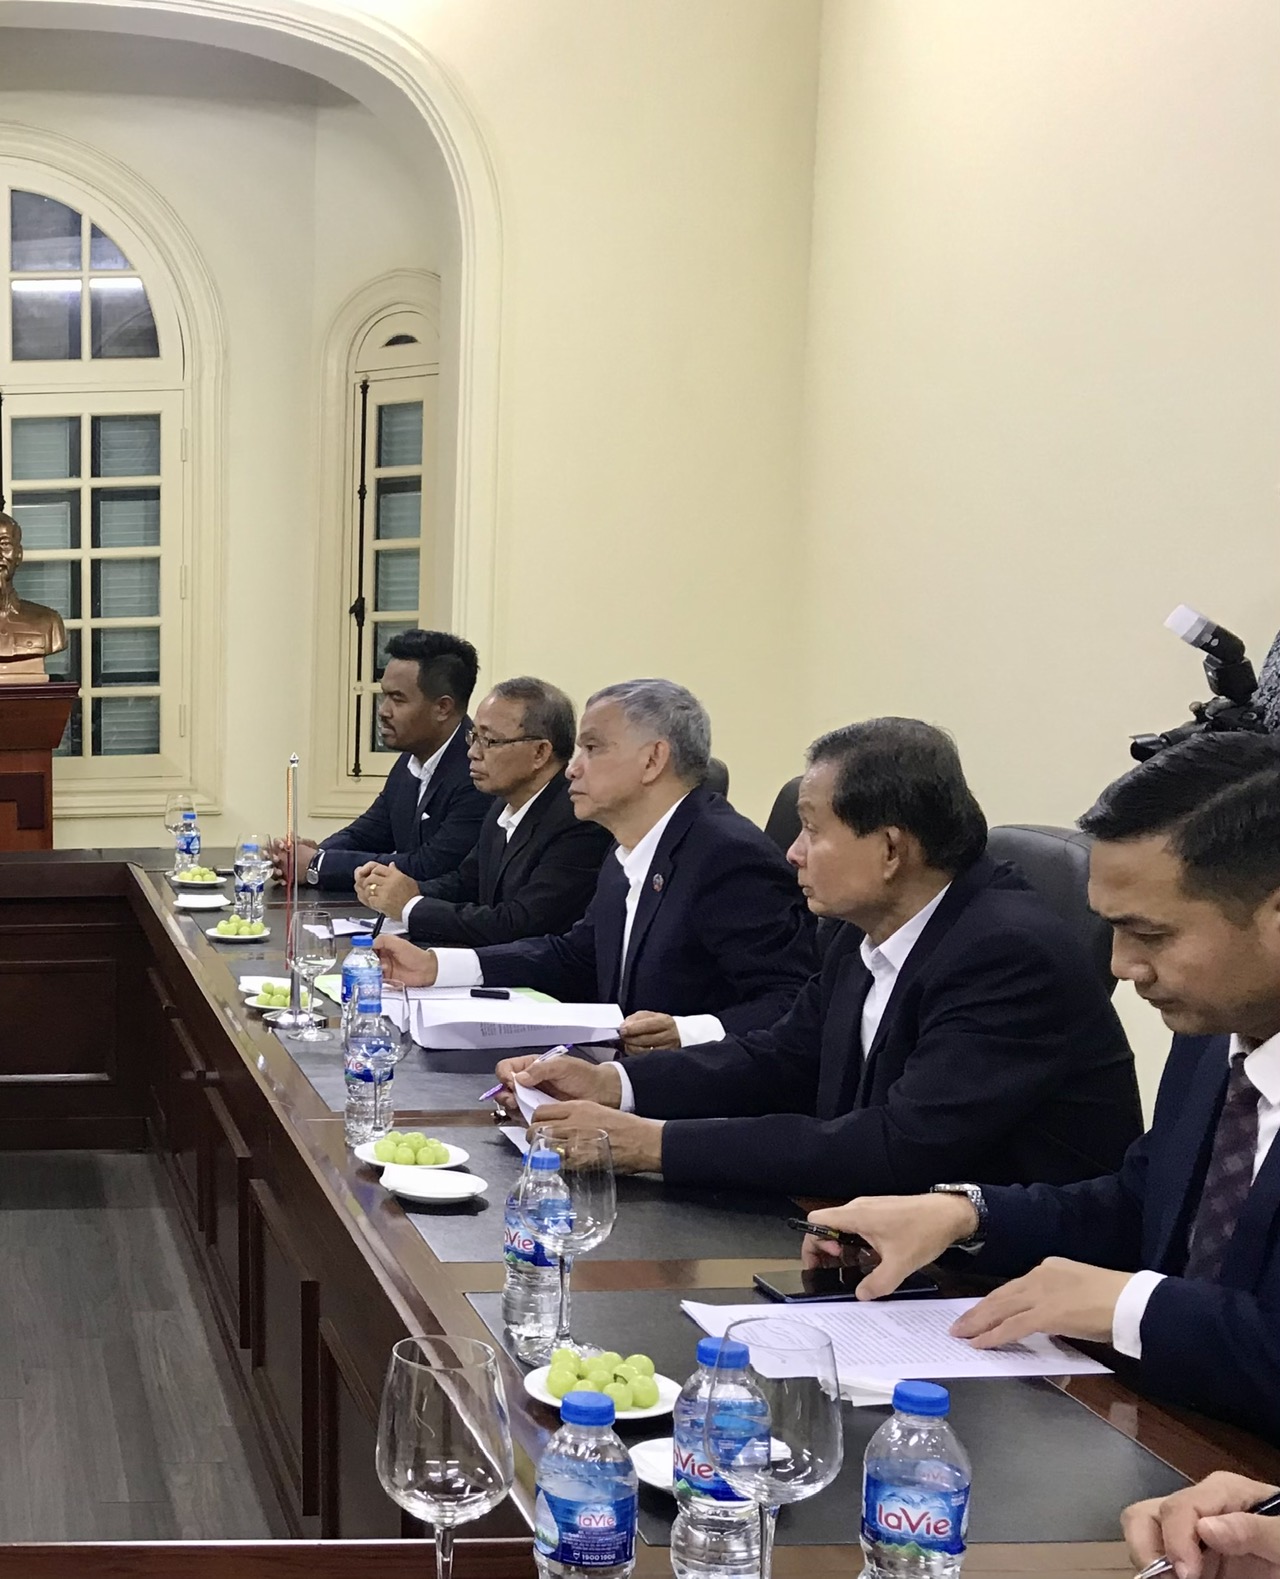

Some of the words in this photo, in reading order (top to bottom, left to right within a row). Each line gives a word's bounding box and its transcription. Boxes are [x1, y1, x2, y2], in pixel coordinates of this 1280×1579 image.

[504, 1227, 534, 1251] Vie
[674, 1444, 714, 1479] Vie
[578, 1513, 615, 1527] laVie
[878, 1503, 951, 1536] laVie
